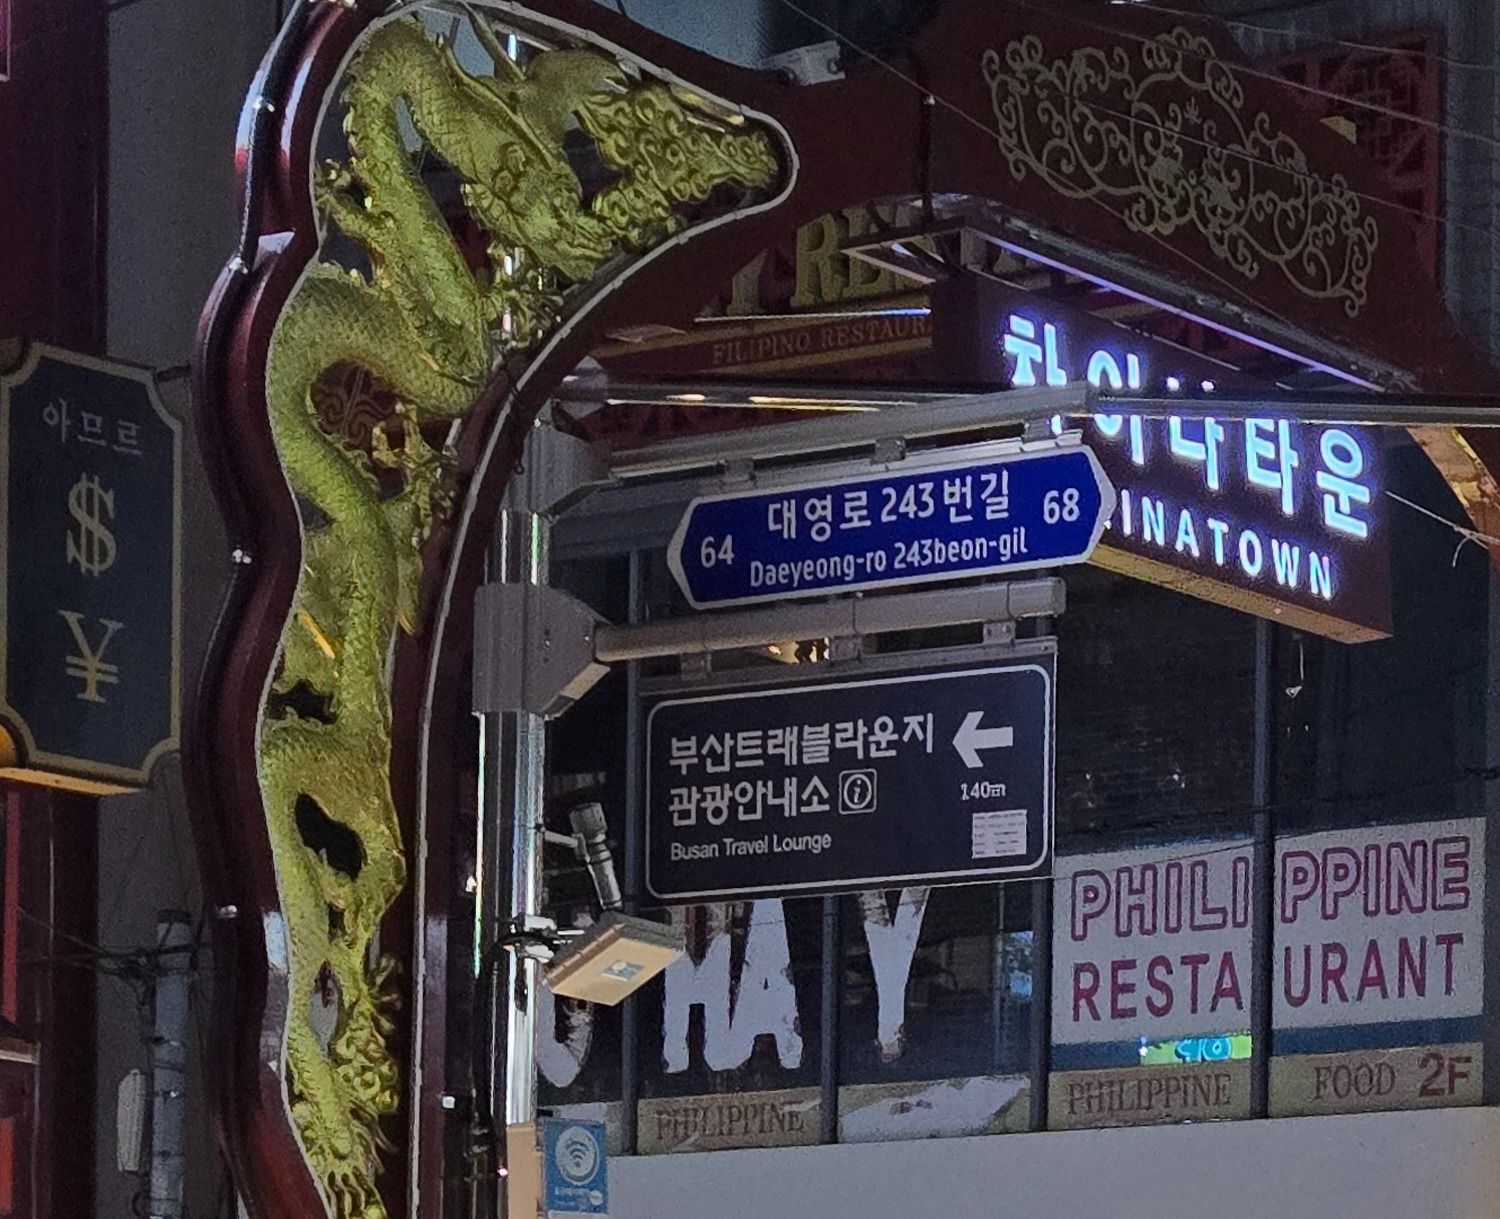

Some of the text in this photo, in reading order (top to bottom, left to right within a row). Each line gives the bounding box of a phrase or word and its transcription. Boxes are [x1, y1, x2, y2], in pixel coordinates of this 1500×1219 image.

[820, 318, 932, 350] RESTAUR
[1004, 314, 1371, 538] 차이나타운
[1042, 487, 1081, 525] 68
[701, 536, 736, 569] 64
[750, 527, 1028, 590] Daeyeong-ro 243beon-gil
[1103, 488, 1334, 601] INATOWN
[669, 712, 934, 775] 부산트래블라운지
[668, 774, 831, 827] 관광안내소
[670, 832, 832, 862] Busan Travel Lounge
[1066, 1073, 1232, 1116] PHILIPPINE
[1313, 1052, 1472, 1100] FOOD 2F
